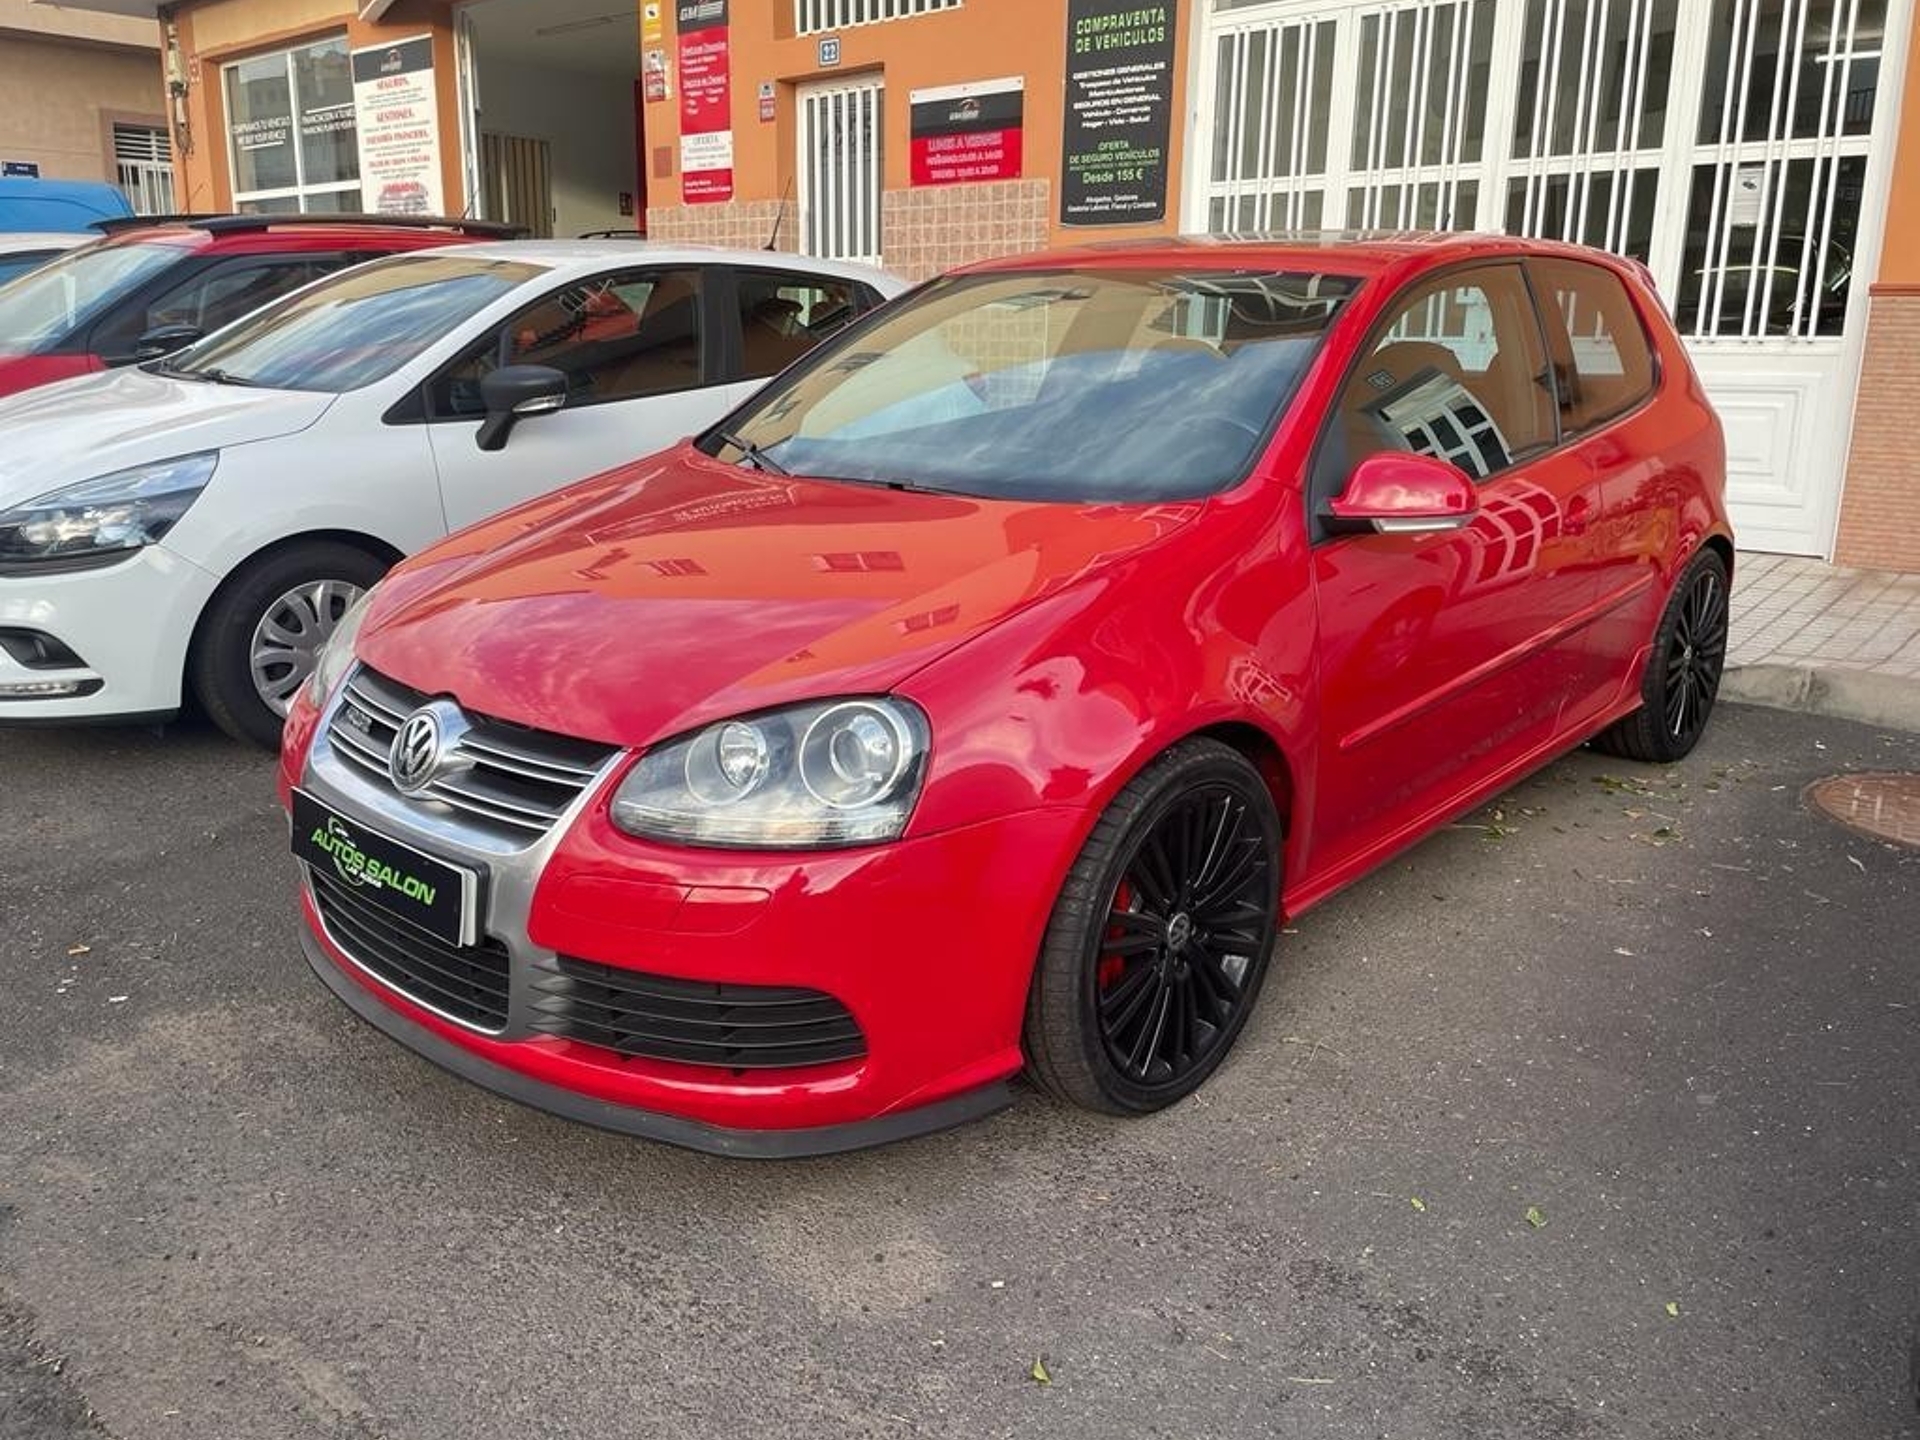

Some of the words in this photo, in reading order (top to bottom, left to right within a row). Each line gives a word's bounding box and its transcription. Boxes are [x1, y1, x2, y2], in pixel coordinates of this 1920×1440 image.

[1076, 7, 1166, 35] COMPRAVENTA
[1075, 38, 1091, 54] DE
[1095, 27, 1165, 50] VEHICULOS
[1098, 140, 1129, 152] OFERTA
[1069, 154, 1080, 164] DE
[1081, 152, 1114, 163] SEGURO
[1082, 171, 1114, 184] Desde
[1117, 168, 1135, 182] 155
[1136, 167, 1144, 181] €
[310, 827, 366, 871] AUTOS
[366, 857, 437, 906] SALON
